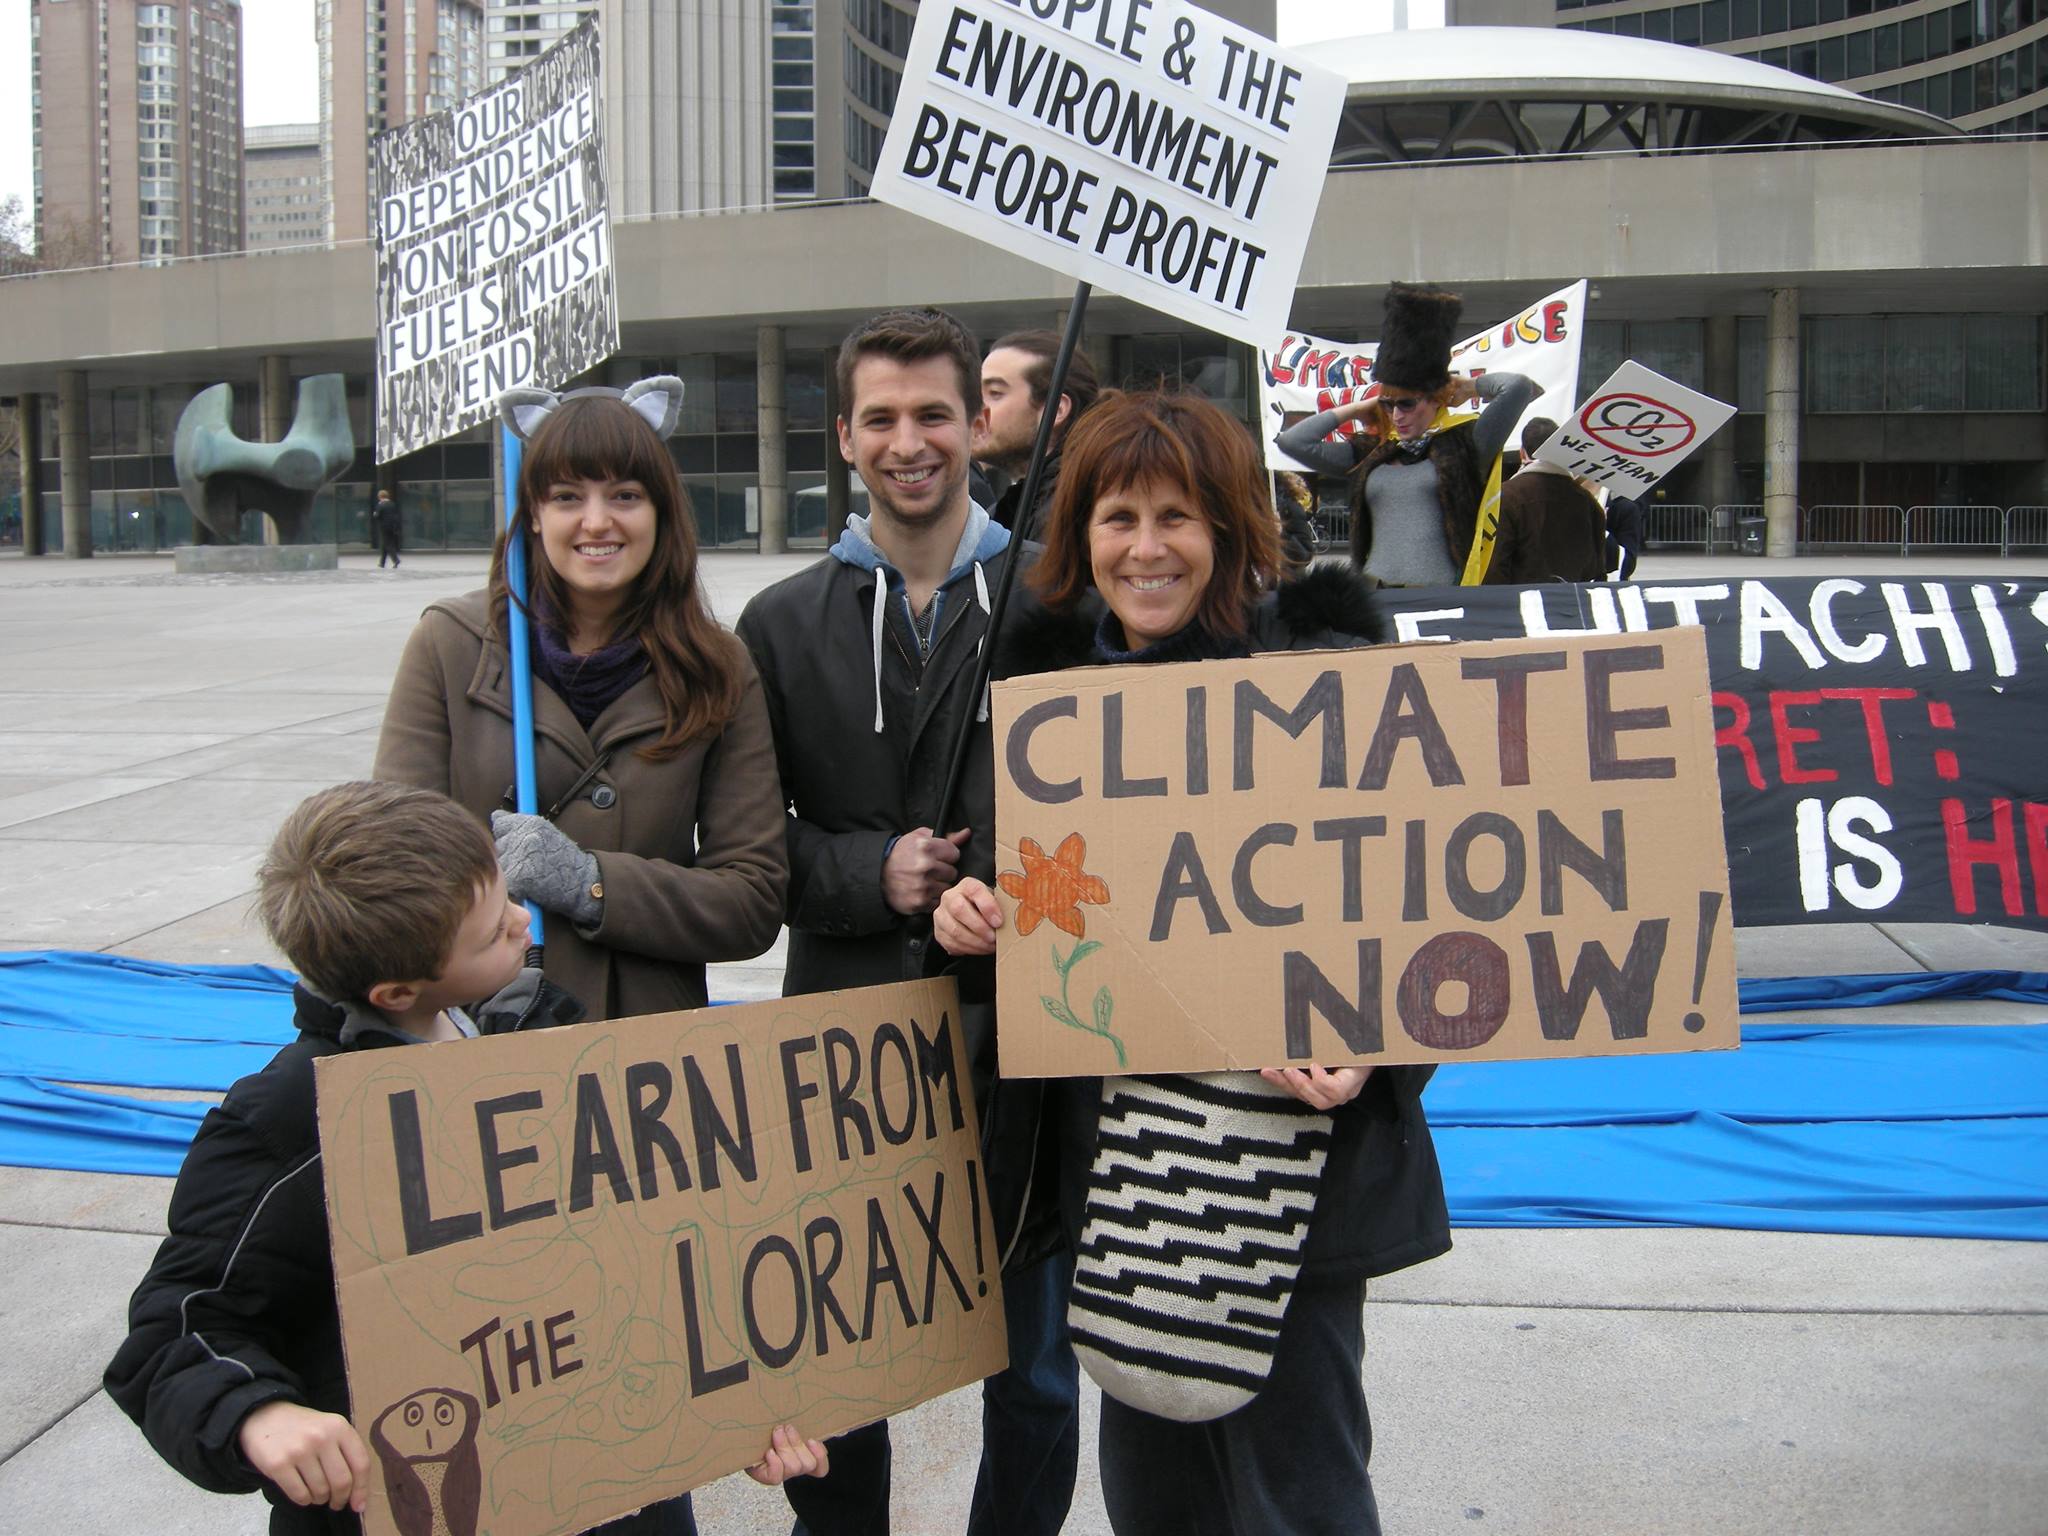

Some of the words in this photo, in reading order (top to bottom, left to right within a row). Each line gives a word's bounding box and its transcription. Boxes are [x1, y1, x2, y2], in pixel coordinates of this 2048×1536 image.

[457, 87, 522, 153] OUR
[935, 5, 1279, 221] ENVIRONMENT
[1163, 16, 1196, 85] &
[1218, 35, 1302, 133] THE
[384, 93, 591, 242] DEPENDENCE
[404, 233, 455, 296] ON
[469, 167, 581, 264] FOSSIL
[902, 103, 1099, 245] BEFORE
[1095, 186, 1266, 312] PROFIT
[389, 279, 499, 371] FUELS
[522, 217, 605, 311] MUST
[464, 336, 533, 409] END
[1560, 435, 1594, 453] WE
[1602, 454, 1660, 484] MEAN
[1568, 459, 1616, 483] IT!
[1520, 577, 2048, 677] HITACHI'
[1005, 644, 1676, 803] CLIMATE
[1150, 809, 1628, 942] ACTION
[1796, 796, 1902, 912] IS
[1283, 891, 1723, 1059] NOW!
[388, 1043, 757, 1255] LEARN
[780, 1011, 965, 1173] FROM
[460, 1310, 583, 1408] THE
[676, 1160, 988, 1398] LORAX!
